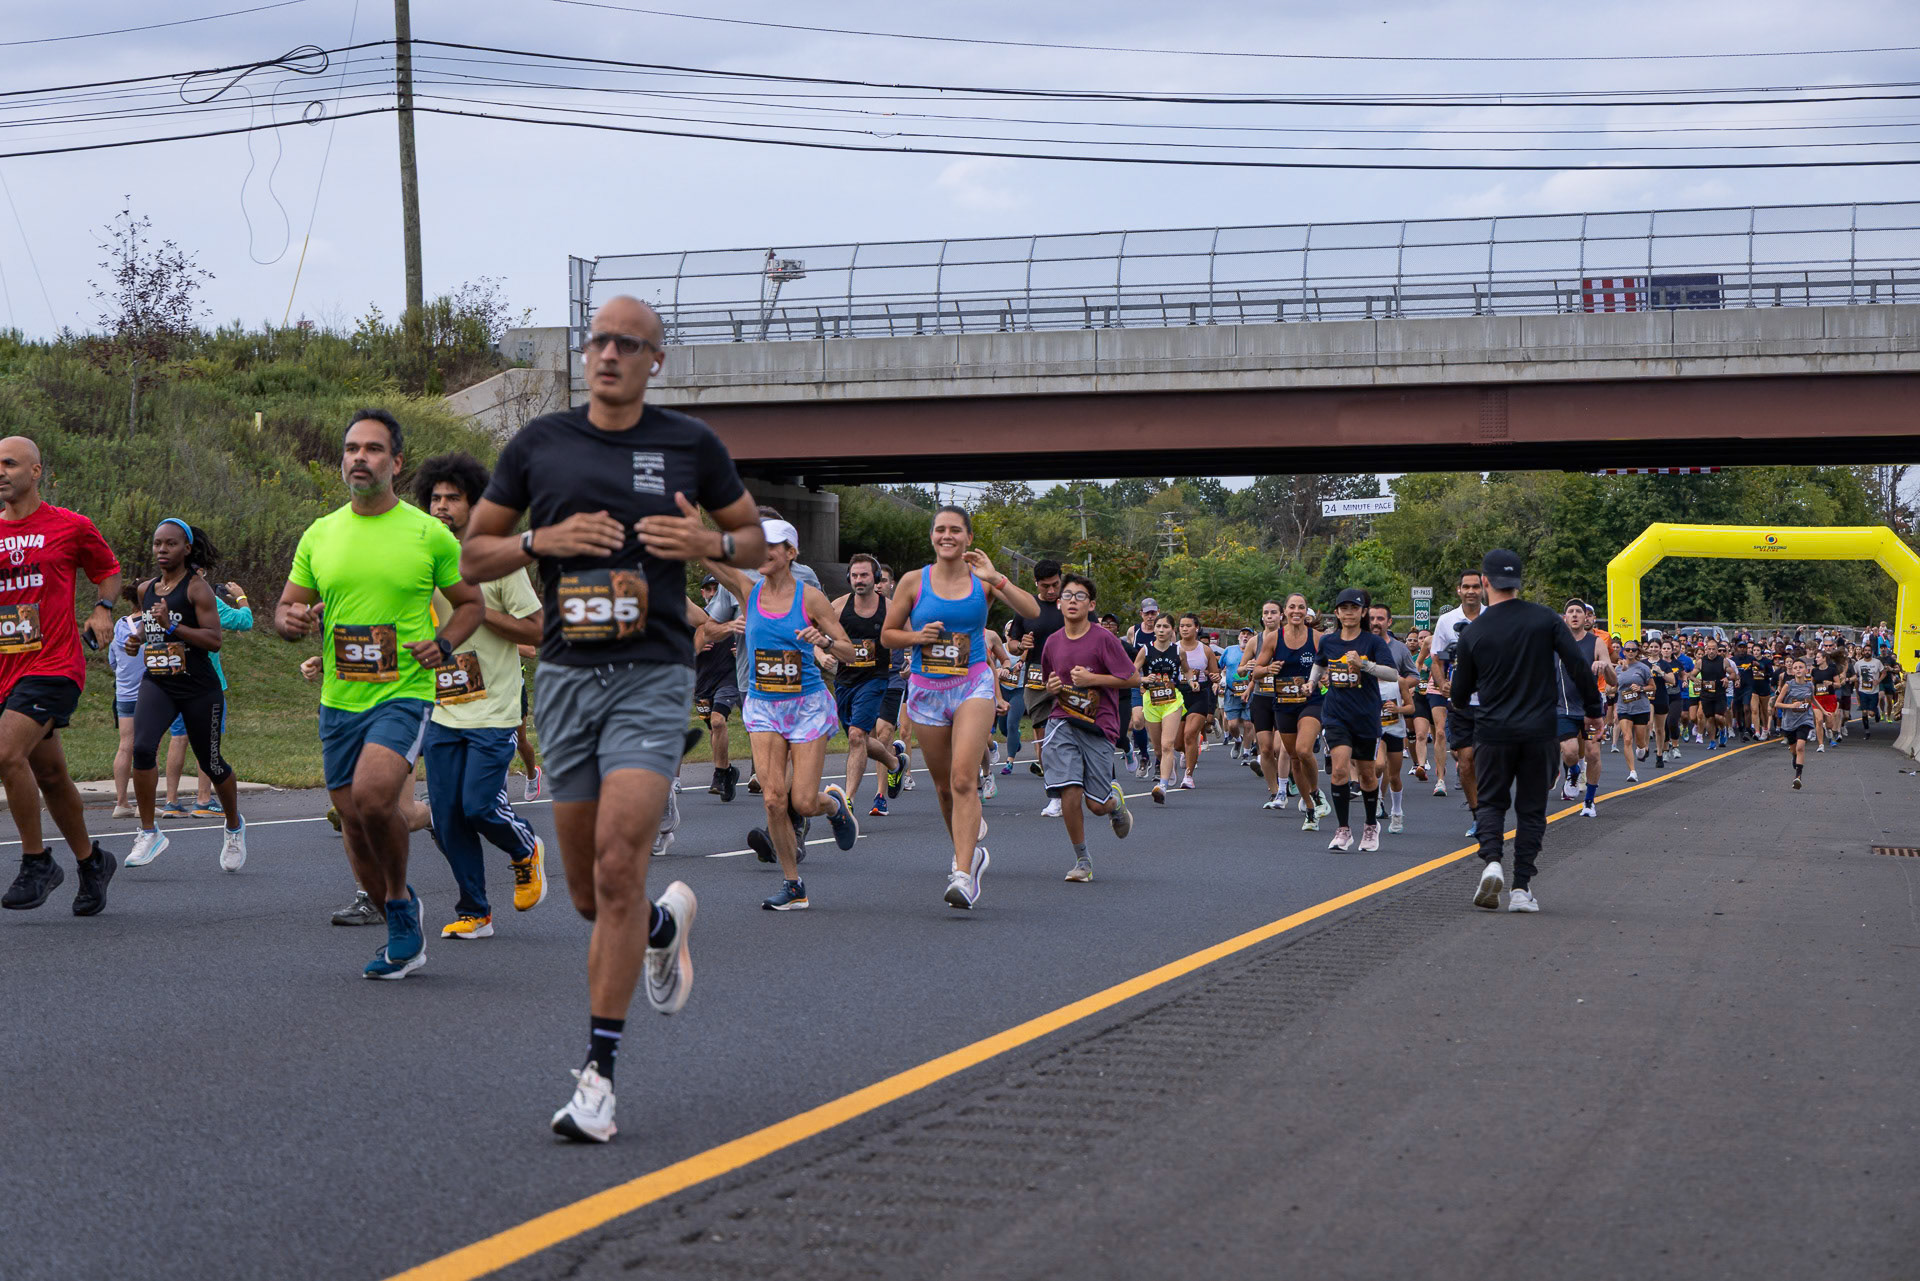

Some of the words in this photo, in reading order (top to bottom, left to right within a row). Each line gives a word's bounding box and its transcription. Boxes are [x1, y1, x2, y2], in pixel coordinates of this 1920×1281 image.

[1325, 504, 1337, 513] 24
[1343, 503, 1371, 511] MINUTE
[169, 610, 182, 621] to
[563, 597, 640, 623] 335
[0, 620, 32, 635] 04
[345, 644, 382, 660] 35
[931, 645, 959, 658] 56
[146, 655, 182, 667] 232
[757, 662, 798, 676] 348
[438, 670, 469, 687] 93
[1331, 672, 1358, 682] 209
[1281, 685, 1299, 694] 43
[1067, 695, 1091, 709] 37
